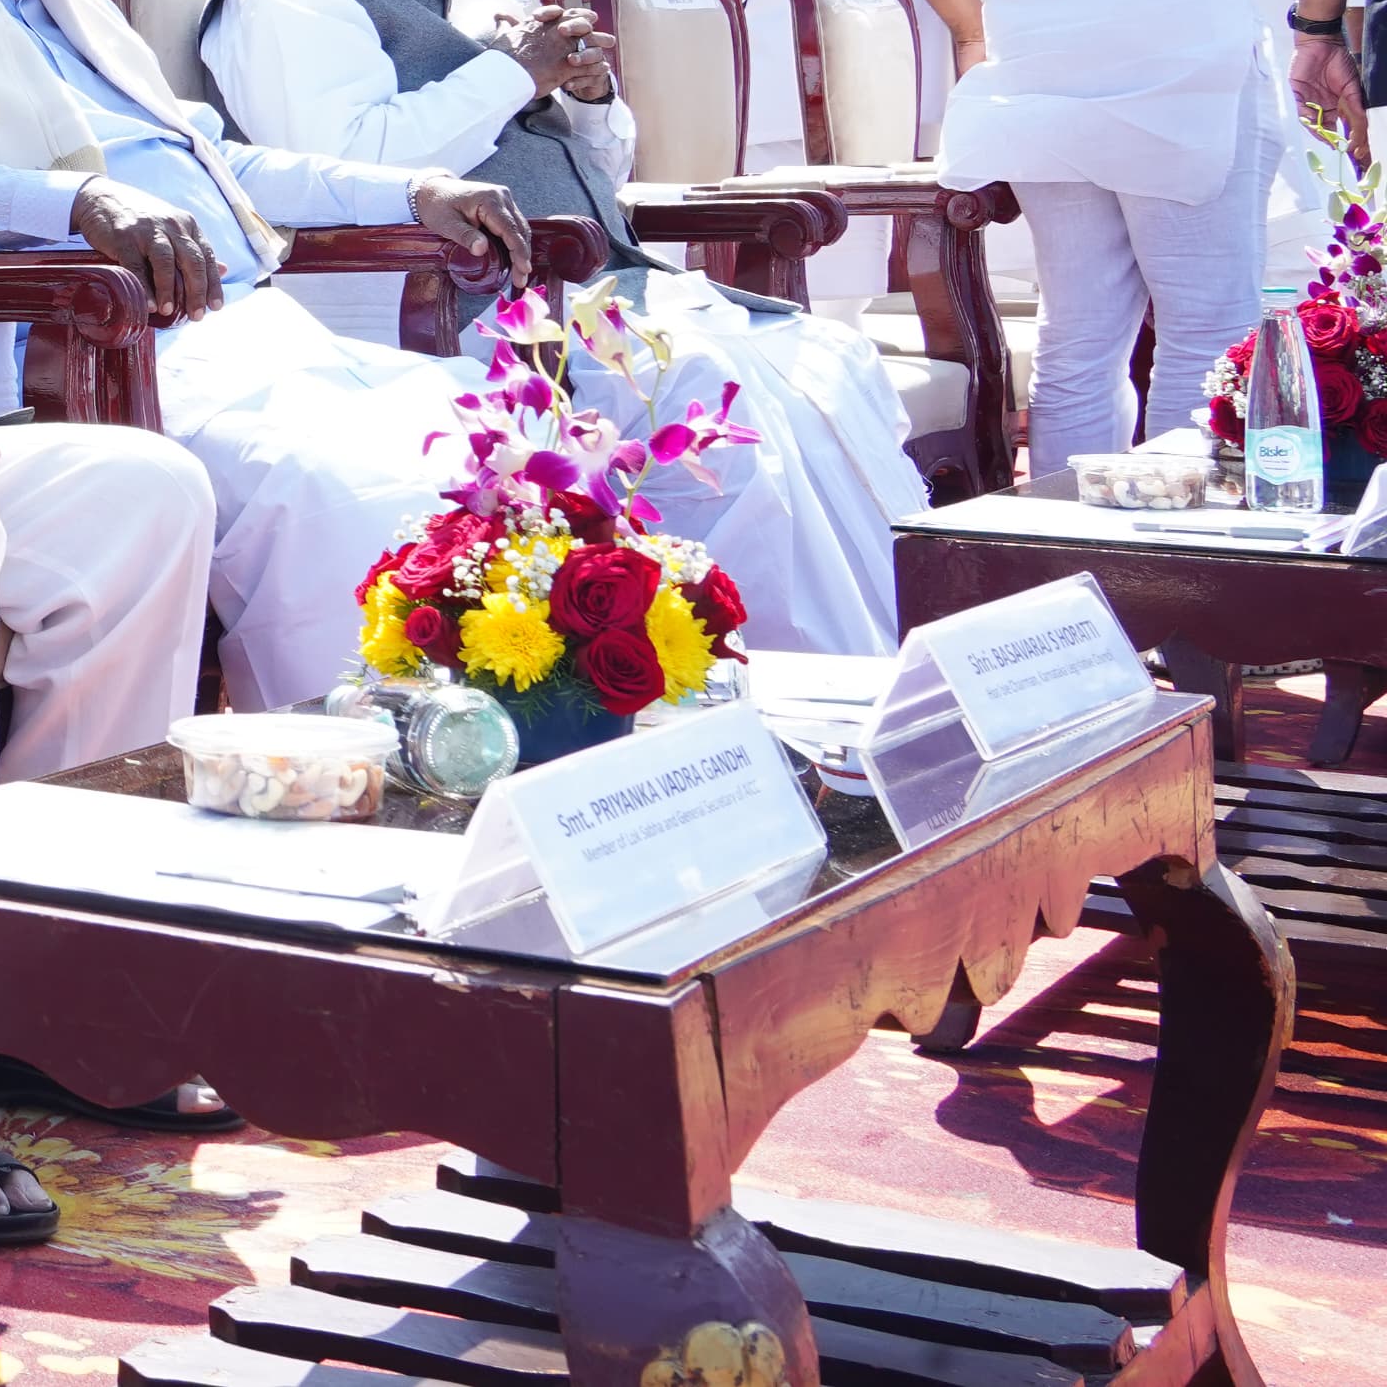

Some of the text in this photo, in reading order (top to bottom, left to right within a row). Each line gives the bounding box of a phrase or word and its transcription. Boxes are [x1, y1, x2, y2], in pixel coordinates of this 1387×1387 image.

[991, 633, 1053, 668] BASAVARAJ
[1047, 630, 1060, 650] S
[1054, 619, 1102, 648] HORATTI
[556, 744, 753, 838] Smt. PRIYANKA VADRA GANDHI
